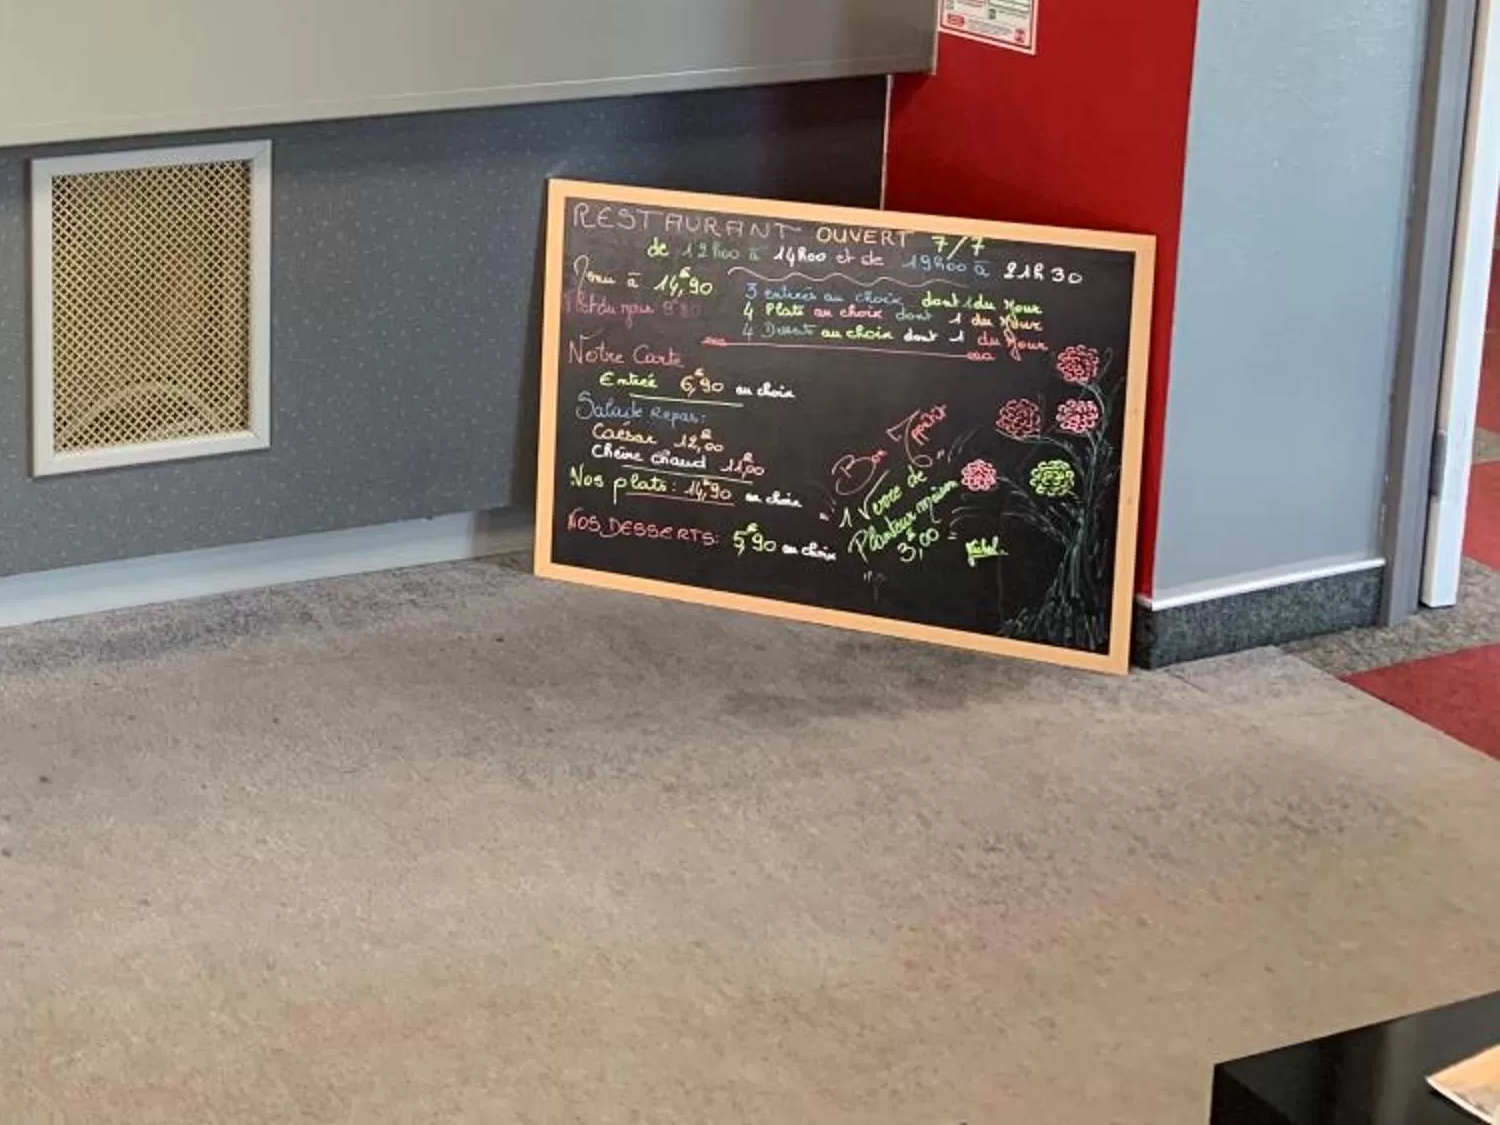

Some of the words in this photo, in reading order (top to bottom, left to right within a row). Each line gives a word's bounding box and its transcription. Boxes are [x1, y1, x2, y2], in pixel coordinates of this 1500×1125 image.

[573, 202, 802, 239] RESTAURANT
[815, 226, 915, 248] OUVERT
[931, 235, 987, 260] 7/7
[647, 236, 670, 259] de
[836, 246, 857, 265] et
[860, 248, 885, 267] de
[744, 281, 758, 301] 3
[823, 291, 845, 303] au
[854, 290, 905, 306] choix
[743, 300, 755, 322] 4
[813, 305, 835, 319] au
[839, 303, 885, 321] choix
[894, 308, 935, 324] dont
[970, 312, 996, 329] du
[567, 332, 625, 365] Notre
[632, 343, 685, 369] Carte
[820, 328, 843, 340] au
[844, 324, 896, 342] choix
[902, 326, 941, 344] dont
[976, 330, 1002, 348] du
[575, 390, 644, 420] Salade
[735, 384, 754, 397] au
[756, 381, 797, 399] choix
[569, 462, 604, 488] Nos
[744, 491, 764, 504] au
[764, 488, 804, 509] choix
[839, 506, 853, 528] 1
[907, 464, 929, 489] de
[781, 543, 799, 556] au
[800, 540, 837, 563] choix
